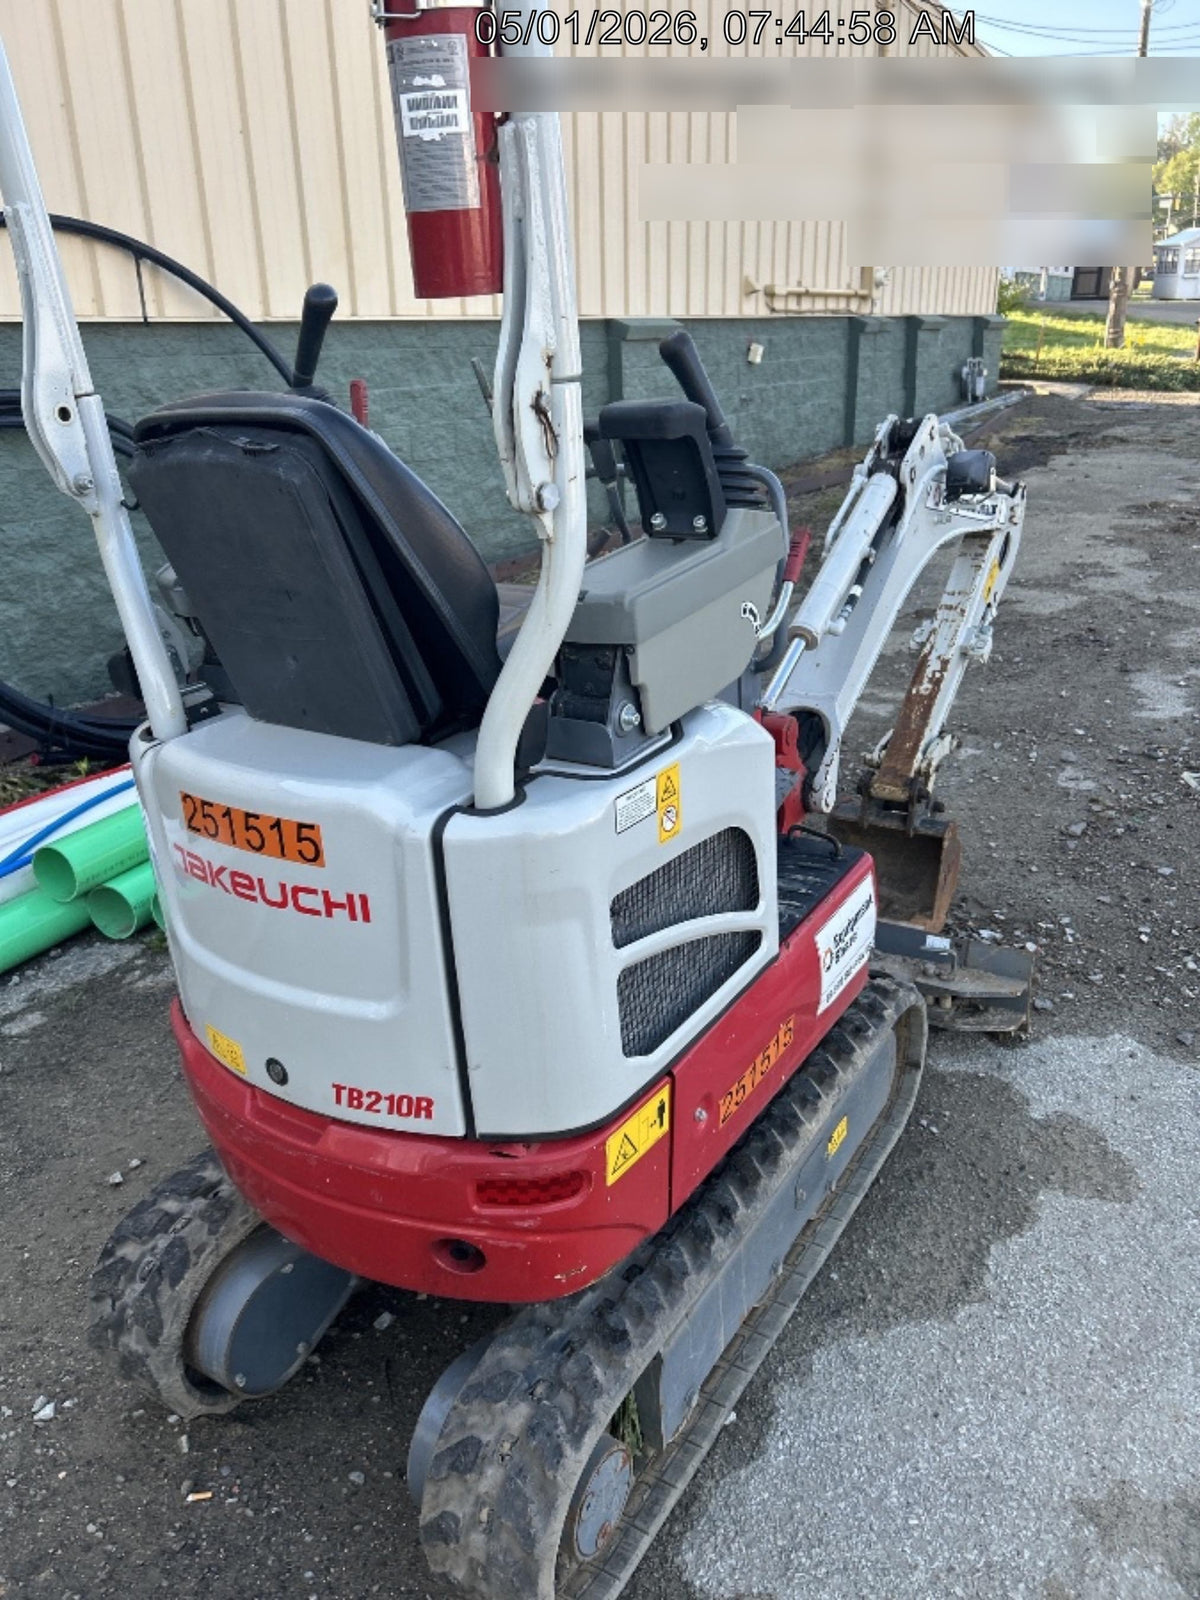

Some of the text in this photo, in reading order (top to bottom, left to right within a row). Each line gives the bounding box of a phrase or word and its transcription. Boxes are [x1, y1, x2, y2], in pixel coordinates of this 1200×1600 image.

[182, 793, 321, 863] 251515
[332, 1083, 434, 1120] TB210R
[721, 1018, 795, 1122] 251515
